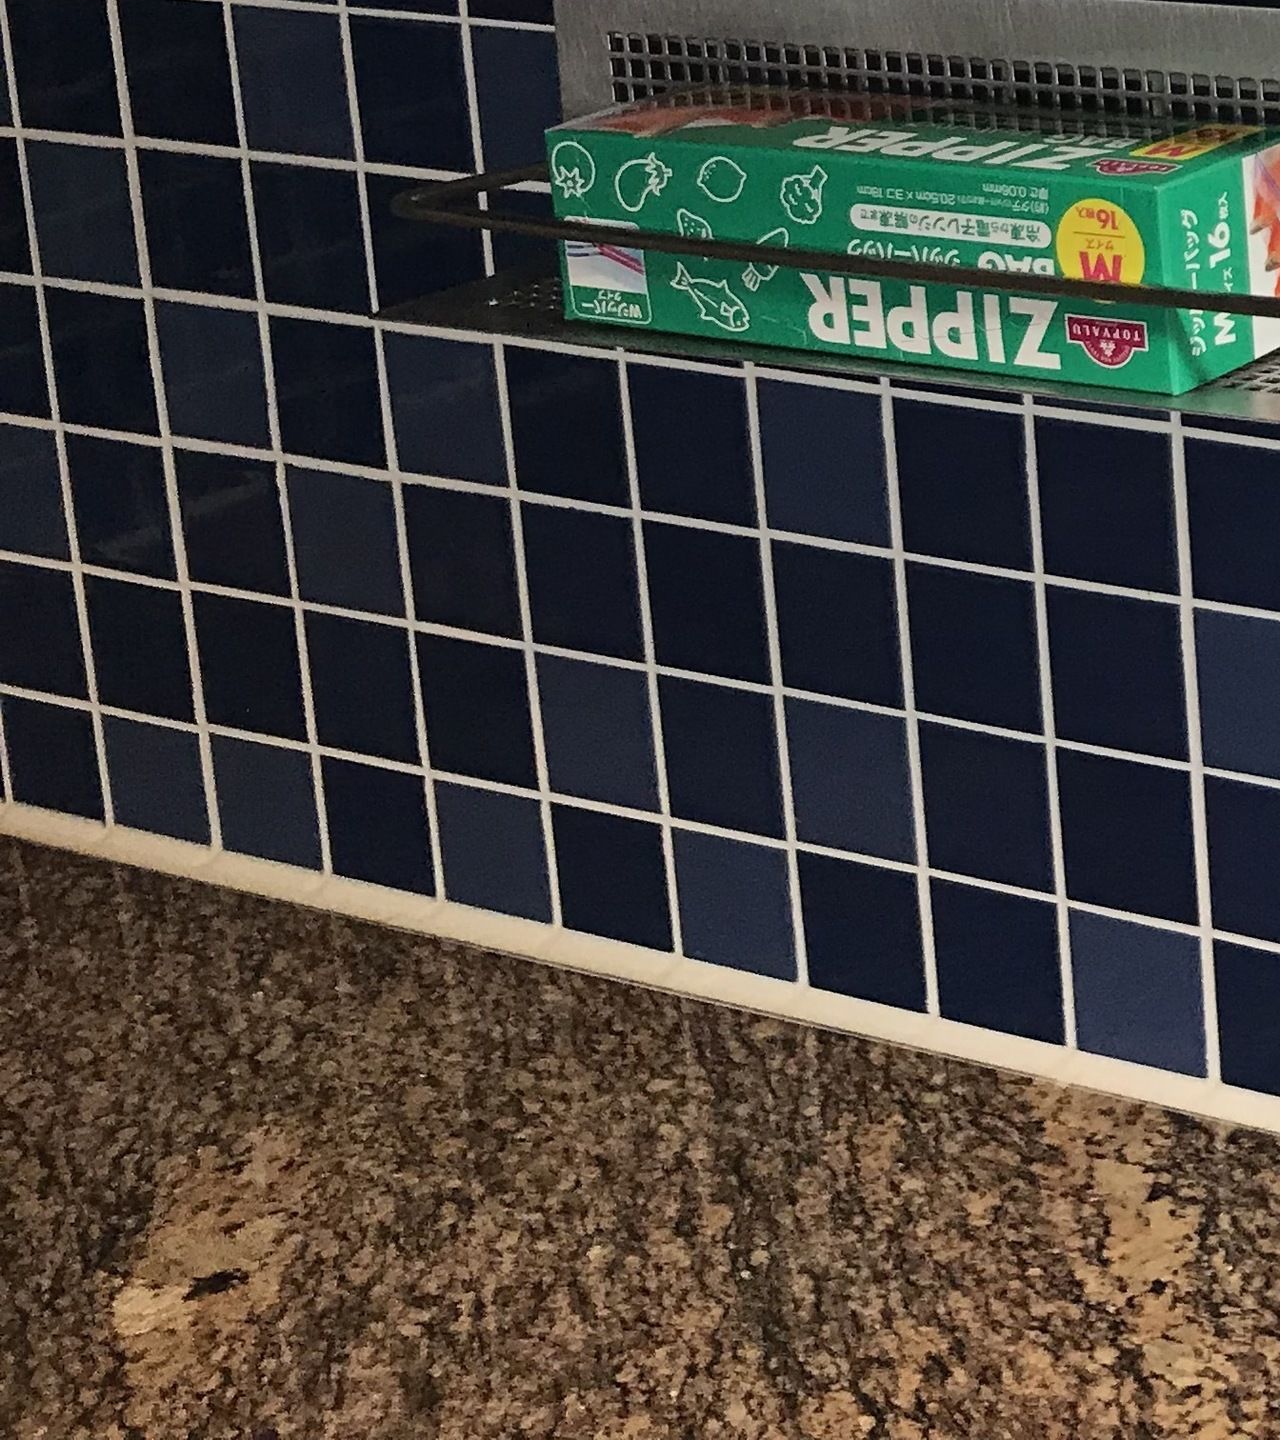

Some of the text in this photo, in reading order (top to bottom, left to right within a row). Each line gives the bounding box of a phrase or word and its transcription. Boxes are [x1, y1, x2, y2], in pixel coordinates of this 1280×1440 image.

[792, 125, 1115, 171] ZIPPER
[1180, 209, 1207, 357] ジッーバッグ
[798, 271, 1062, 370] ZIPPER
[1071, 323, 1142, 342] TOPVALU
